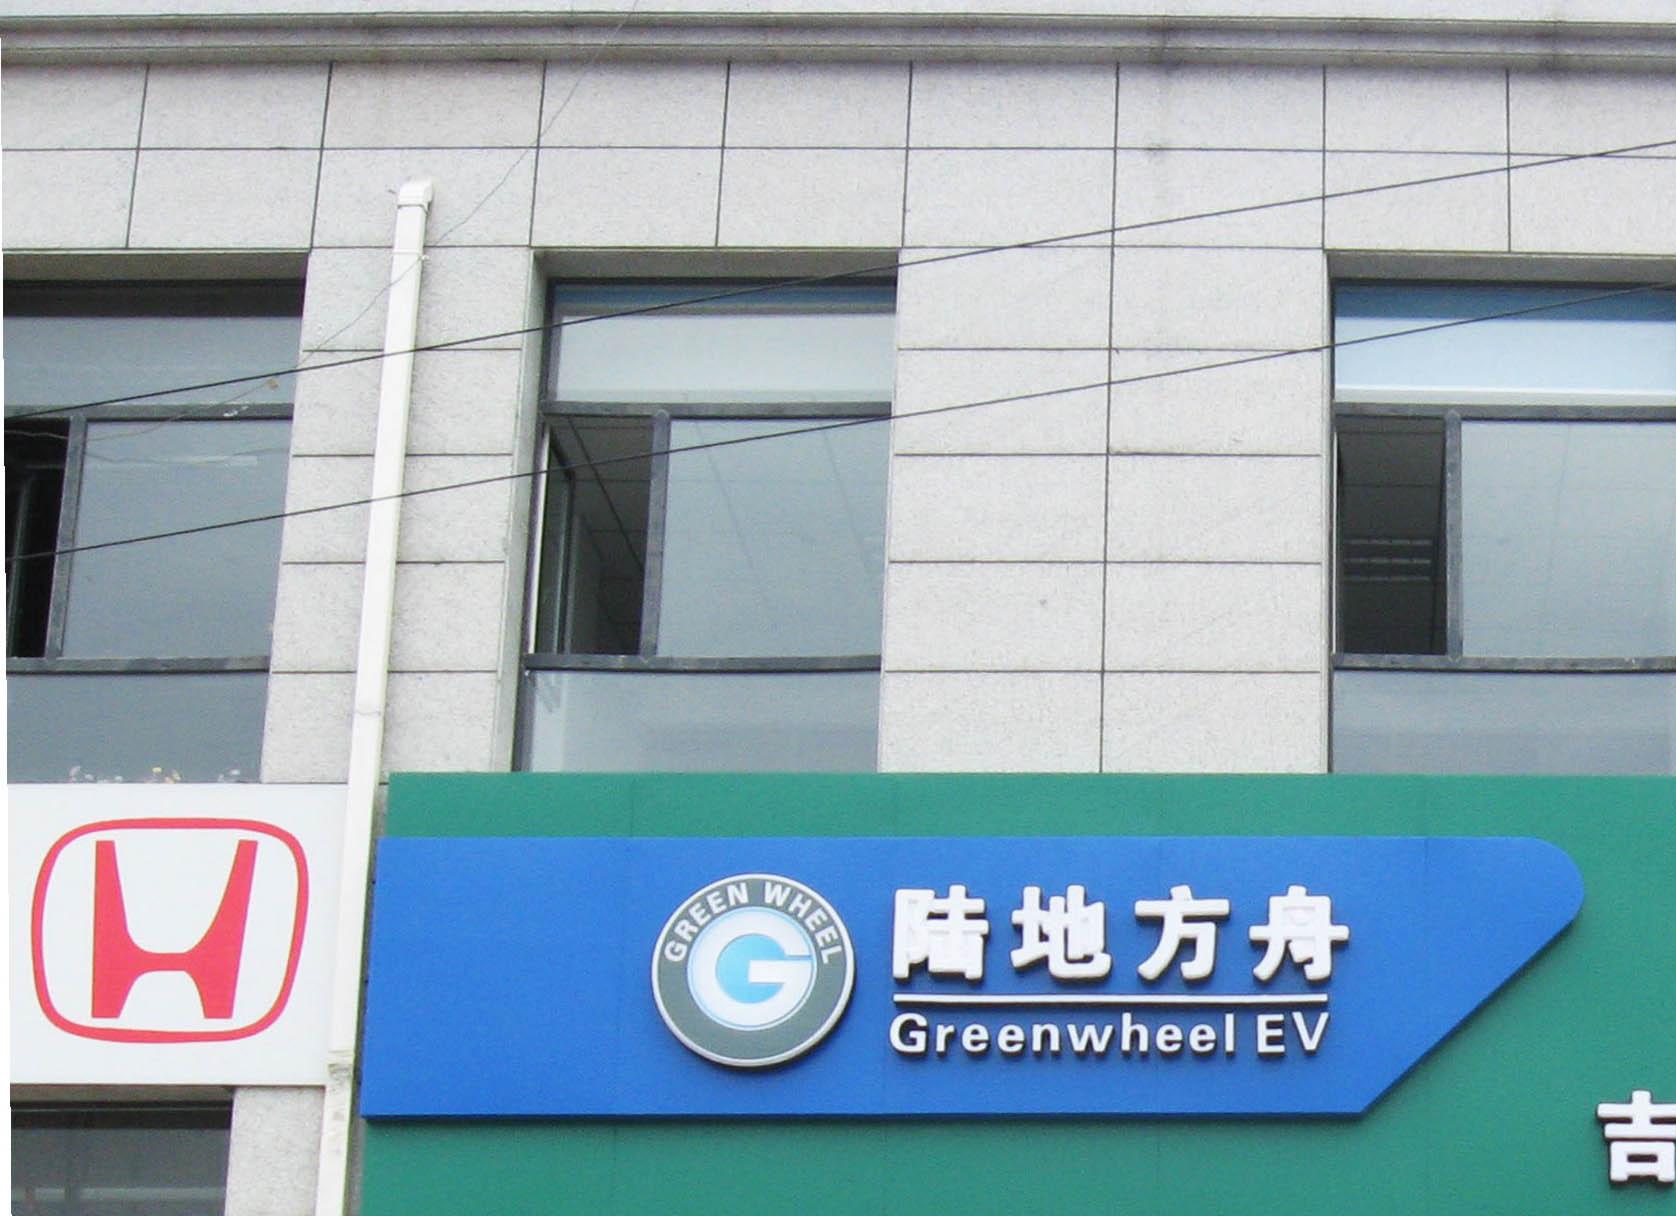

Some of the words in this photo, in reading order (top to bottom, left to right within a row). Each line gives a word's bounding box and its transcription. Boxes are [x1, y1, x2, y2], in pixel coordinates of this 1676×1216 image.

[664, 881, 749, 963] GREEN
[763, 881, 843, 965] WHEEL
[892, 884, 1349, 981] 陆地方舟
[890, 1011, 1235, 1054] Greenwheel
[1257, 1012, 1330, 1054] EV
